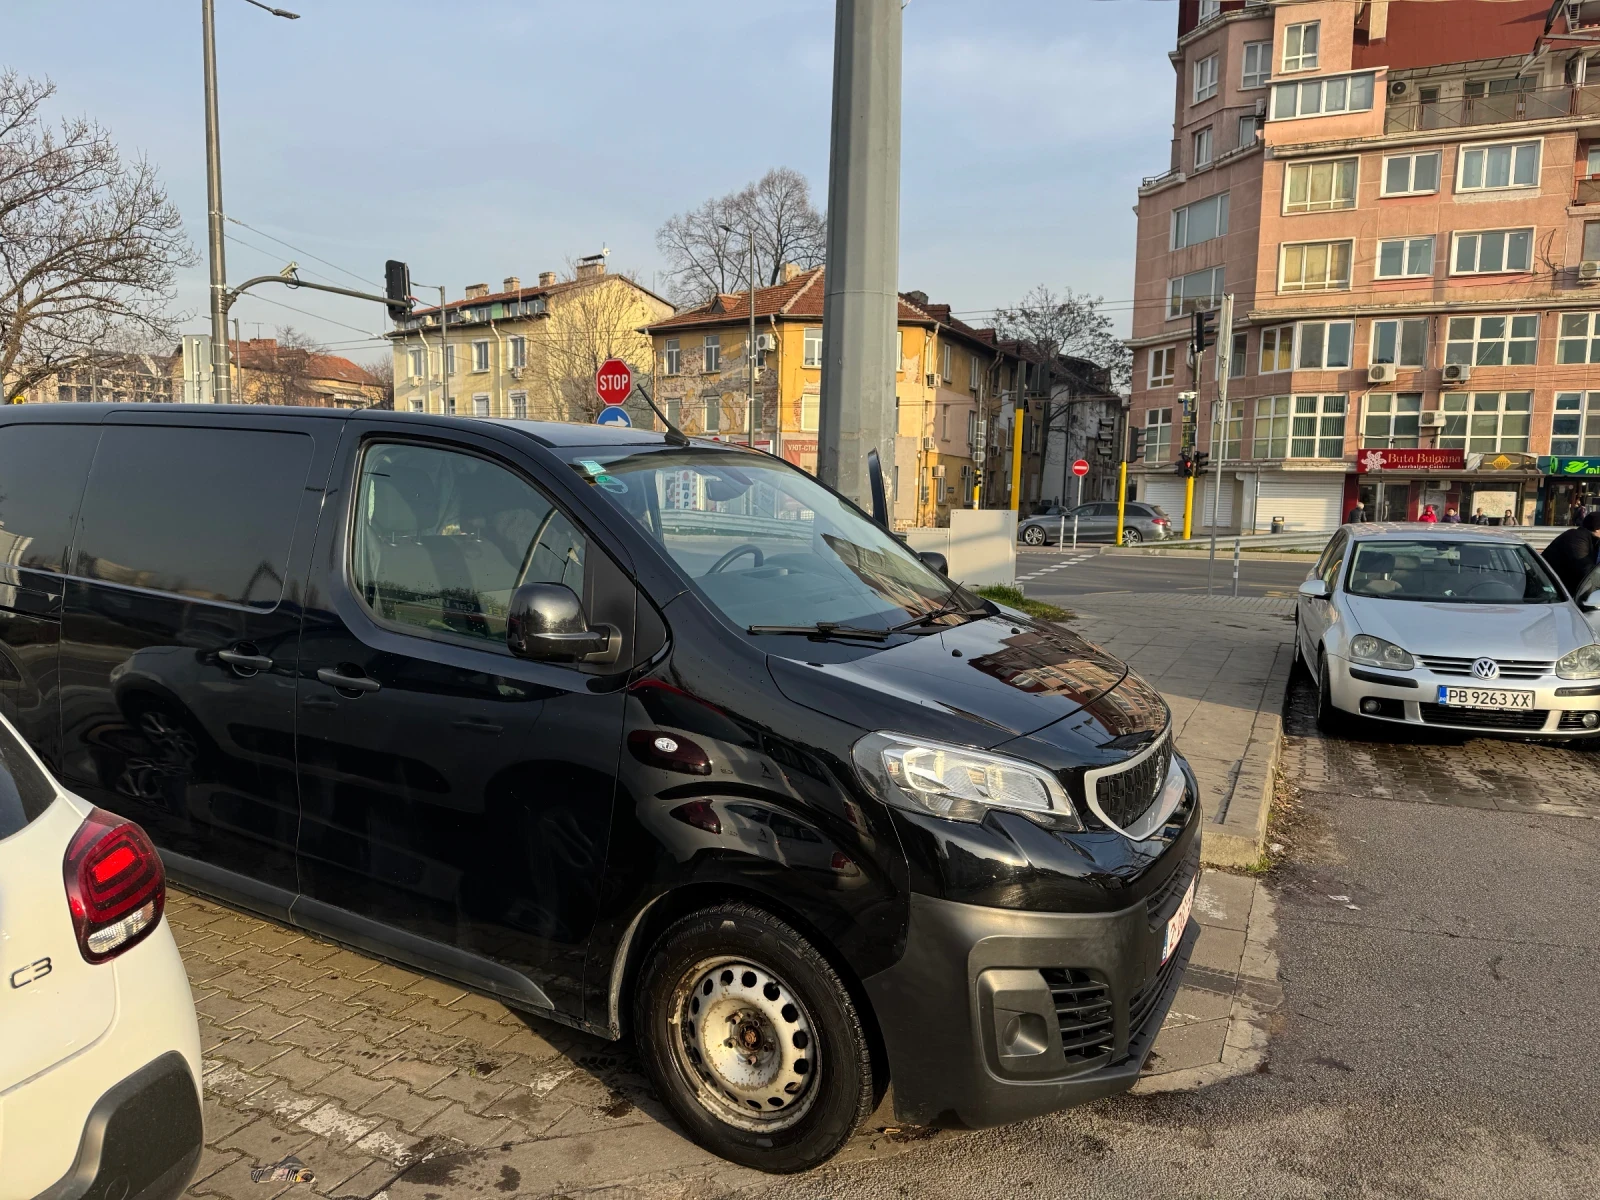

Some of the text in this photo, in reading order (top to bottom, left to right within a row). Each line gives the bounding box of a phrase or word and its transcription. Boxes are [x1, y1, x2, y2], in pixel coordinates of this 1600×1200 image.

[600, 374, 628, 390] STOP
[1388, 453, 1414, 463] Buta
[1449, 690, 1468, 703] PB
[1472, 691, 1507, 705] 9263
[1511, 693, 1530, 707] XX
[10, 956, 53, 989] C3
